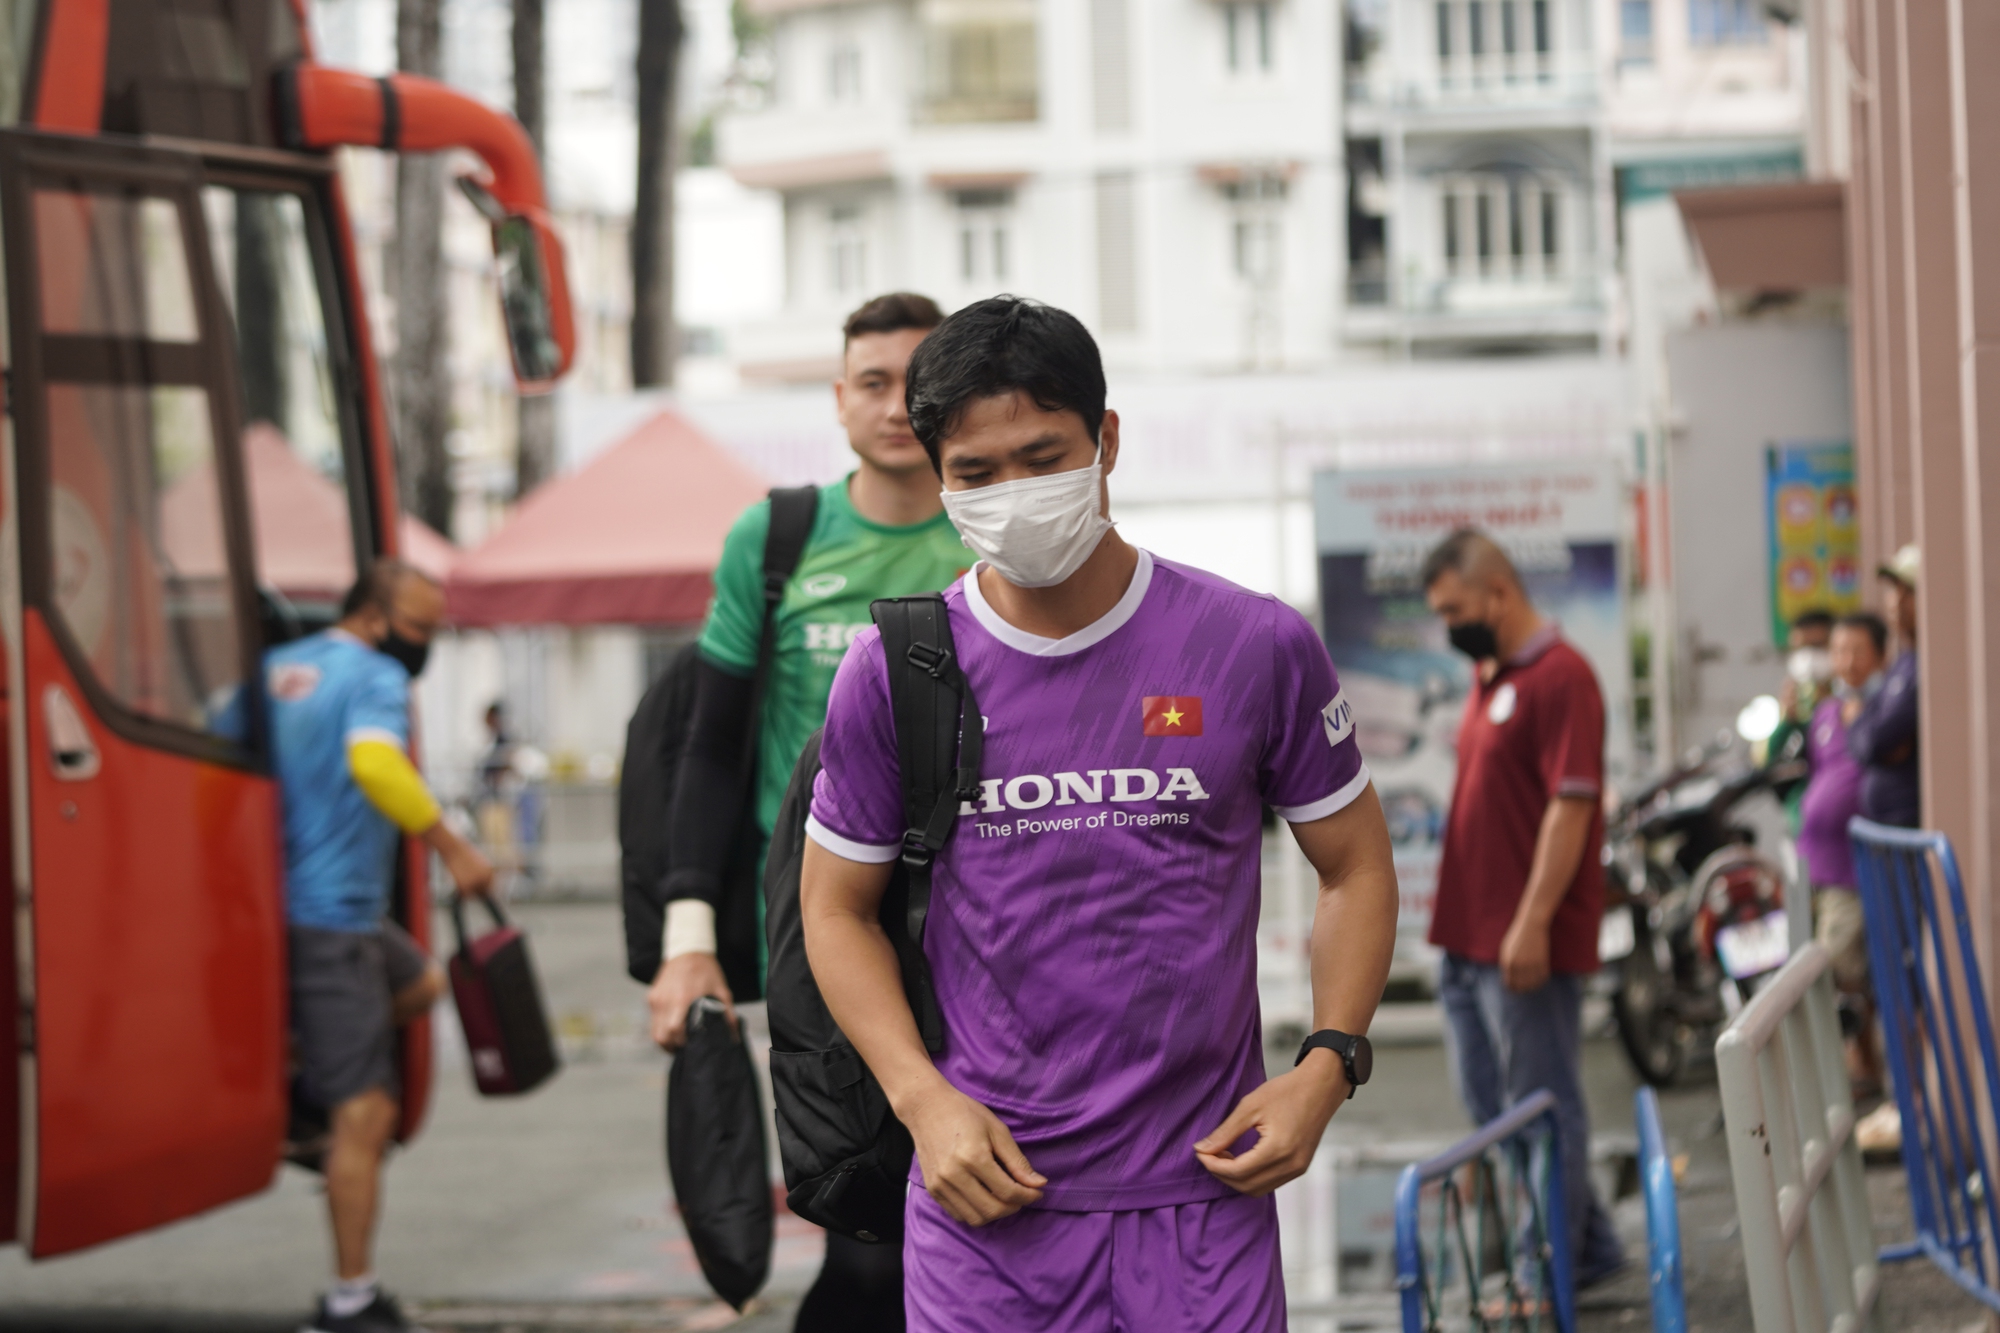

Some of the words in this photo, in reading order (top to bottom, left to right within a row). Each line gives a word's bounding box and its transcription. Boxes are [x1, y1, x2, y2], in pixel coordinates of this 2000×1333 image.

[958, 768, 1210, 816] HONDA
[975, 822, 1012, 838] The
[1017, 816, 1082, 835] Power
[1086, 812, 1108, 829] of
[1113, 811, 1190, 827] Dreams
